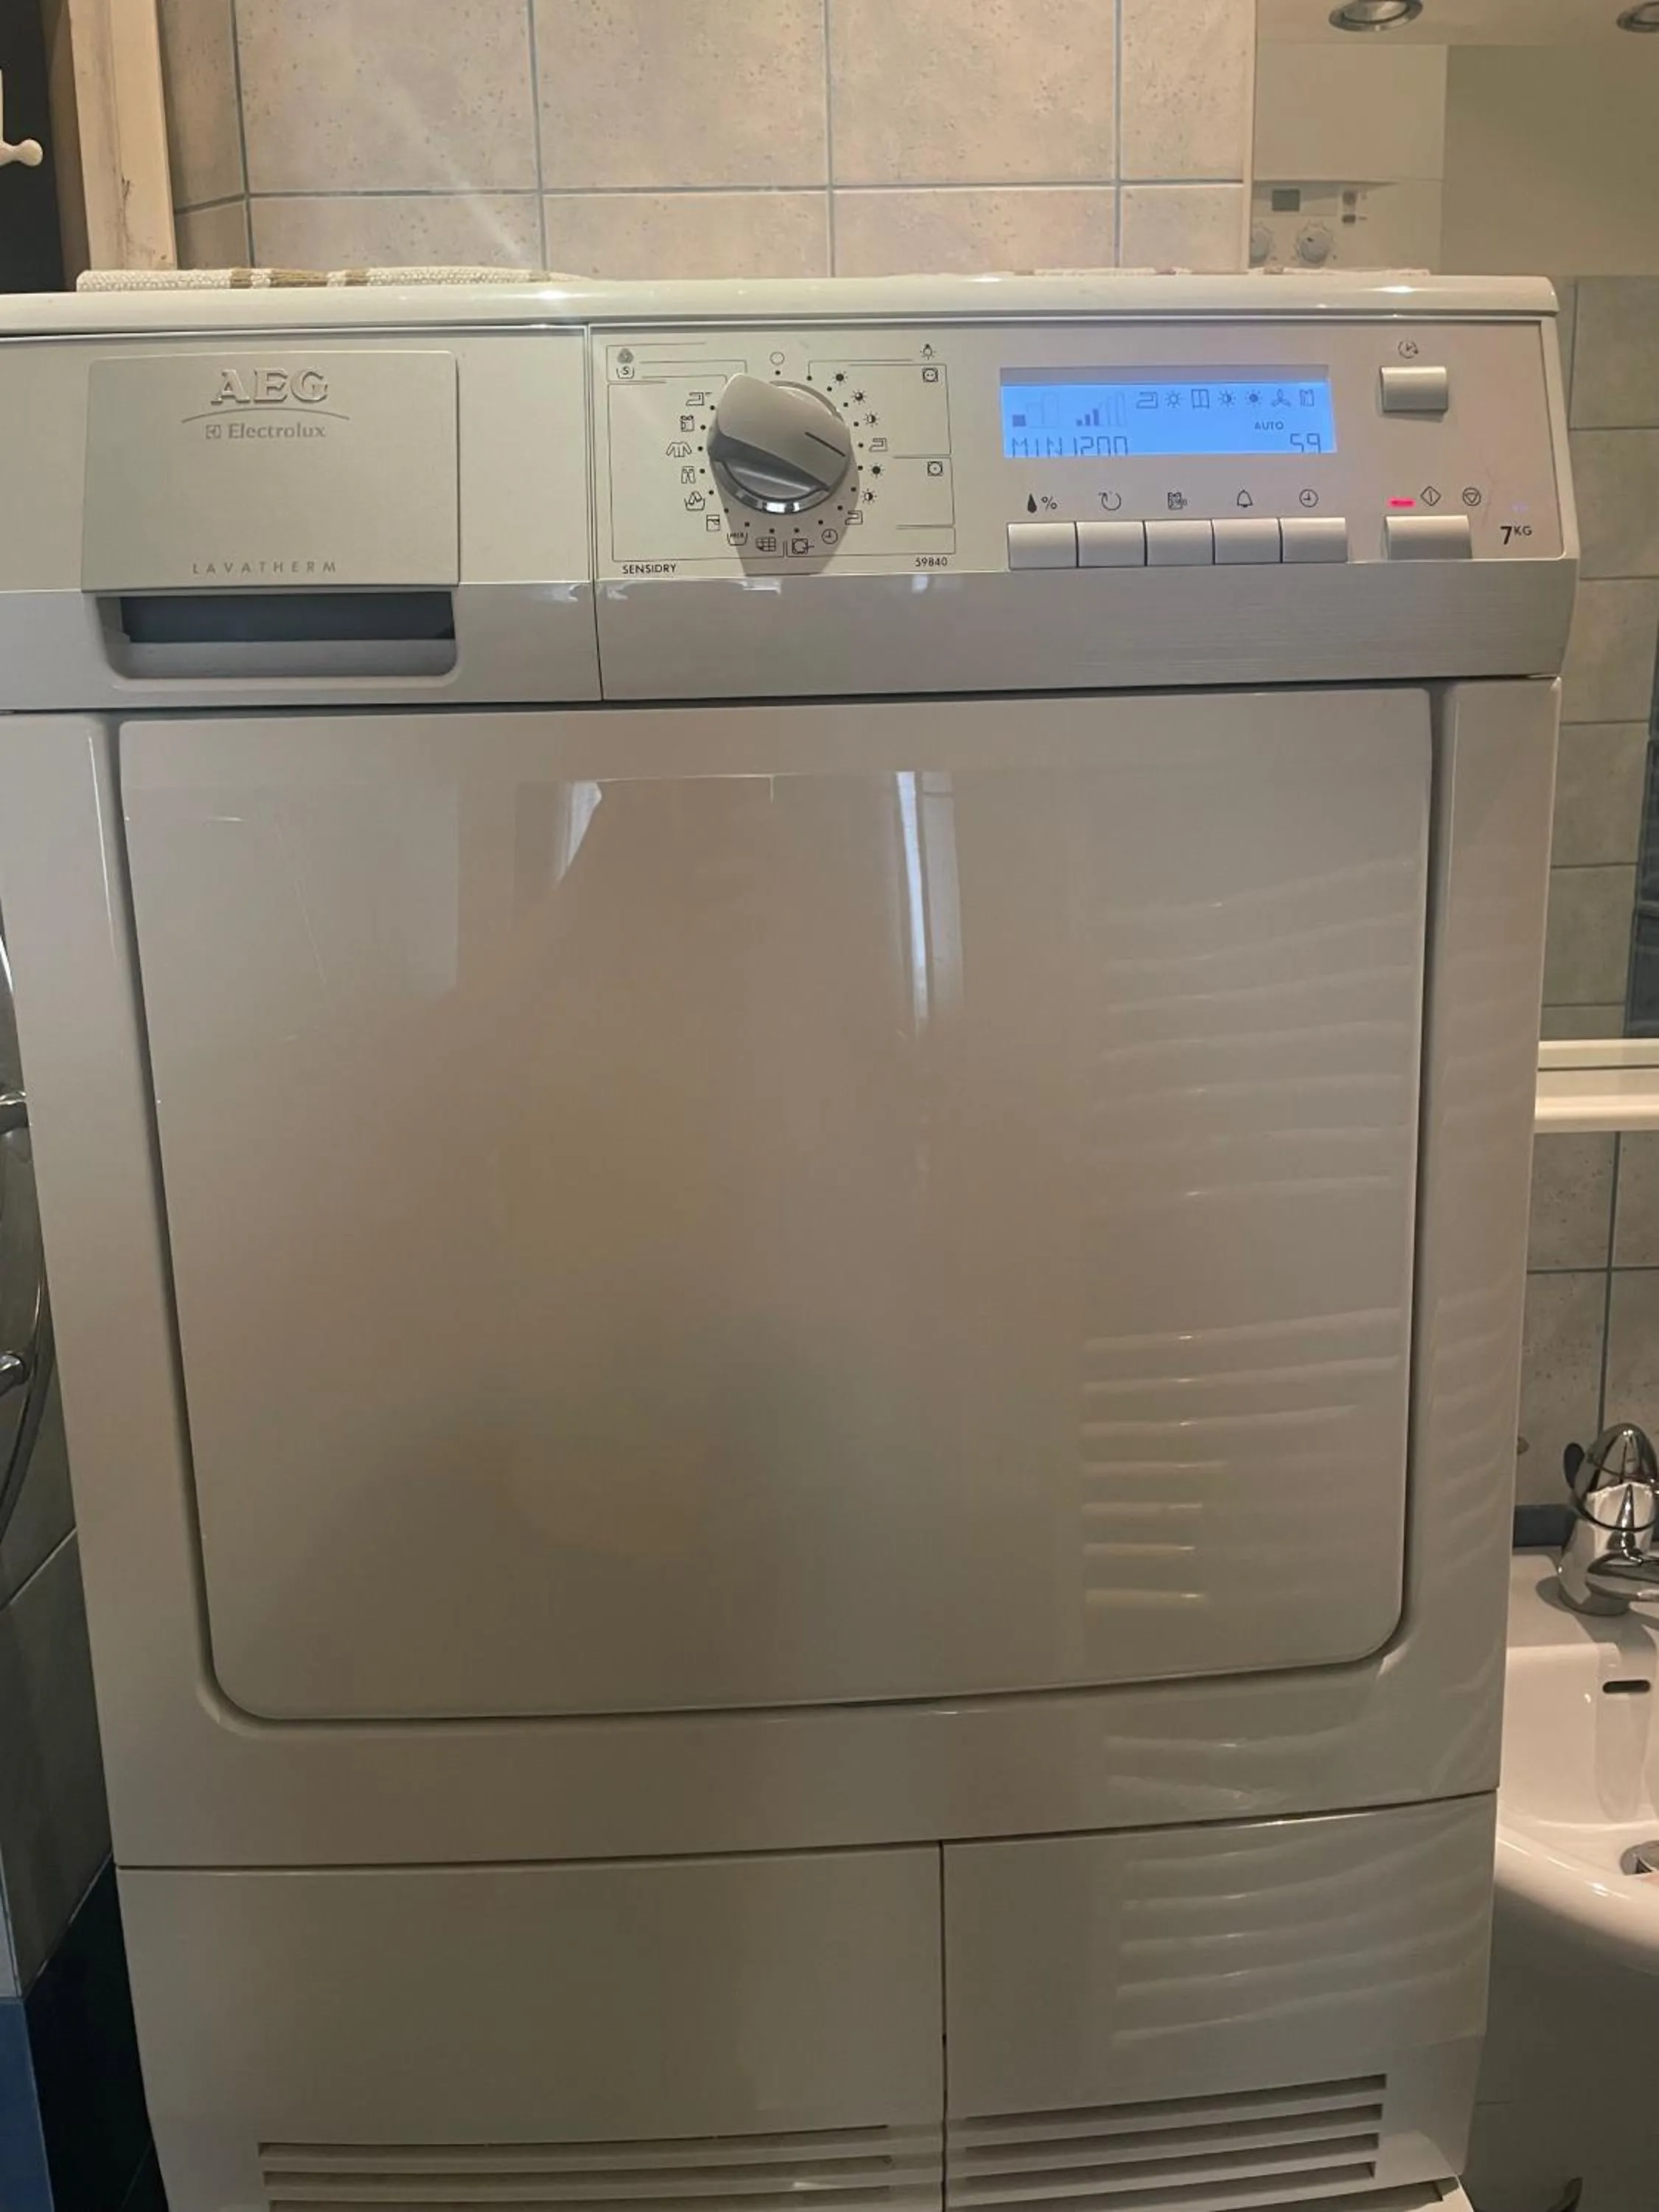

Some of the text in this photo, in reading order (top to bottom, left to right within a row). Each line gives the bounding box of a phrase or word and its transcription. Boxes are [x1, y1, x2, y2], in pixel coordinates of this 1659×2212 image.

[211, 368, 329, 405] AEG
[227, 422, 327, 439] Electrolux
[1254, 420, 1284, 431] AUTO
[1290, 433, 1322, 454] 59
[192, 560, 336, 575] LAVATHERM
[622, 563, 677, 575] SENSIDRY
[914, 556, 948, 567] 59840
